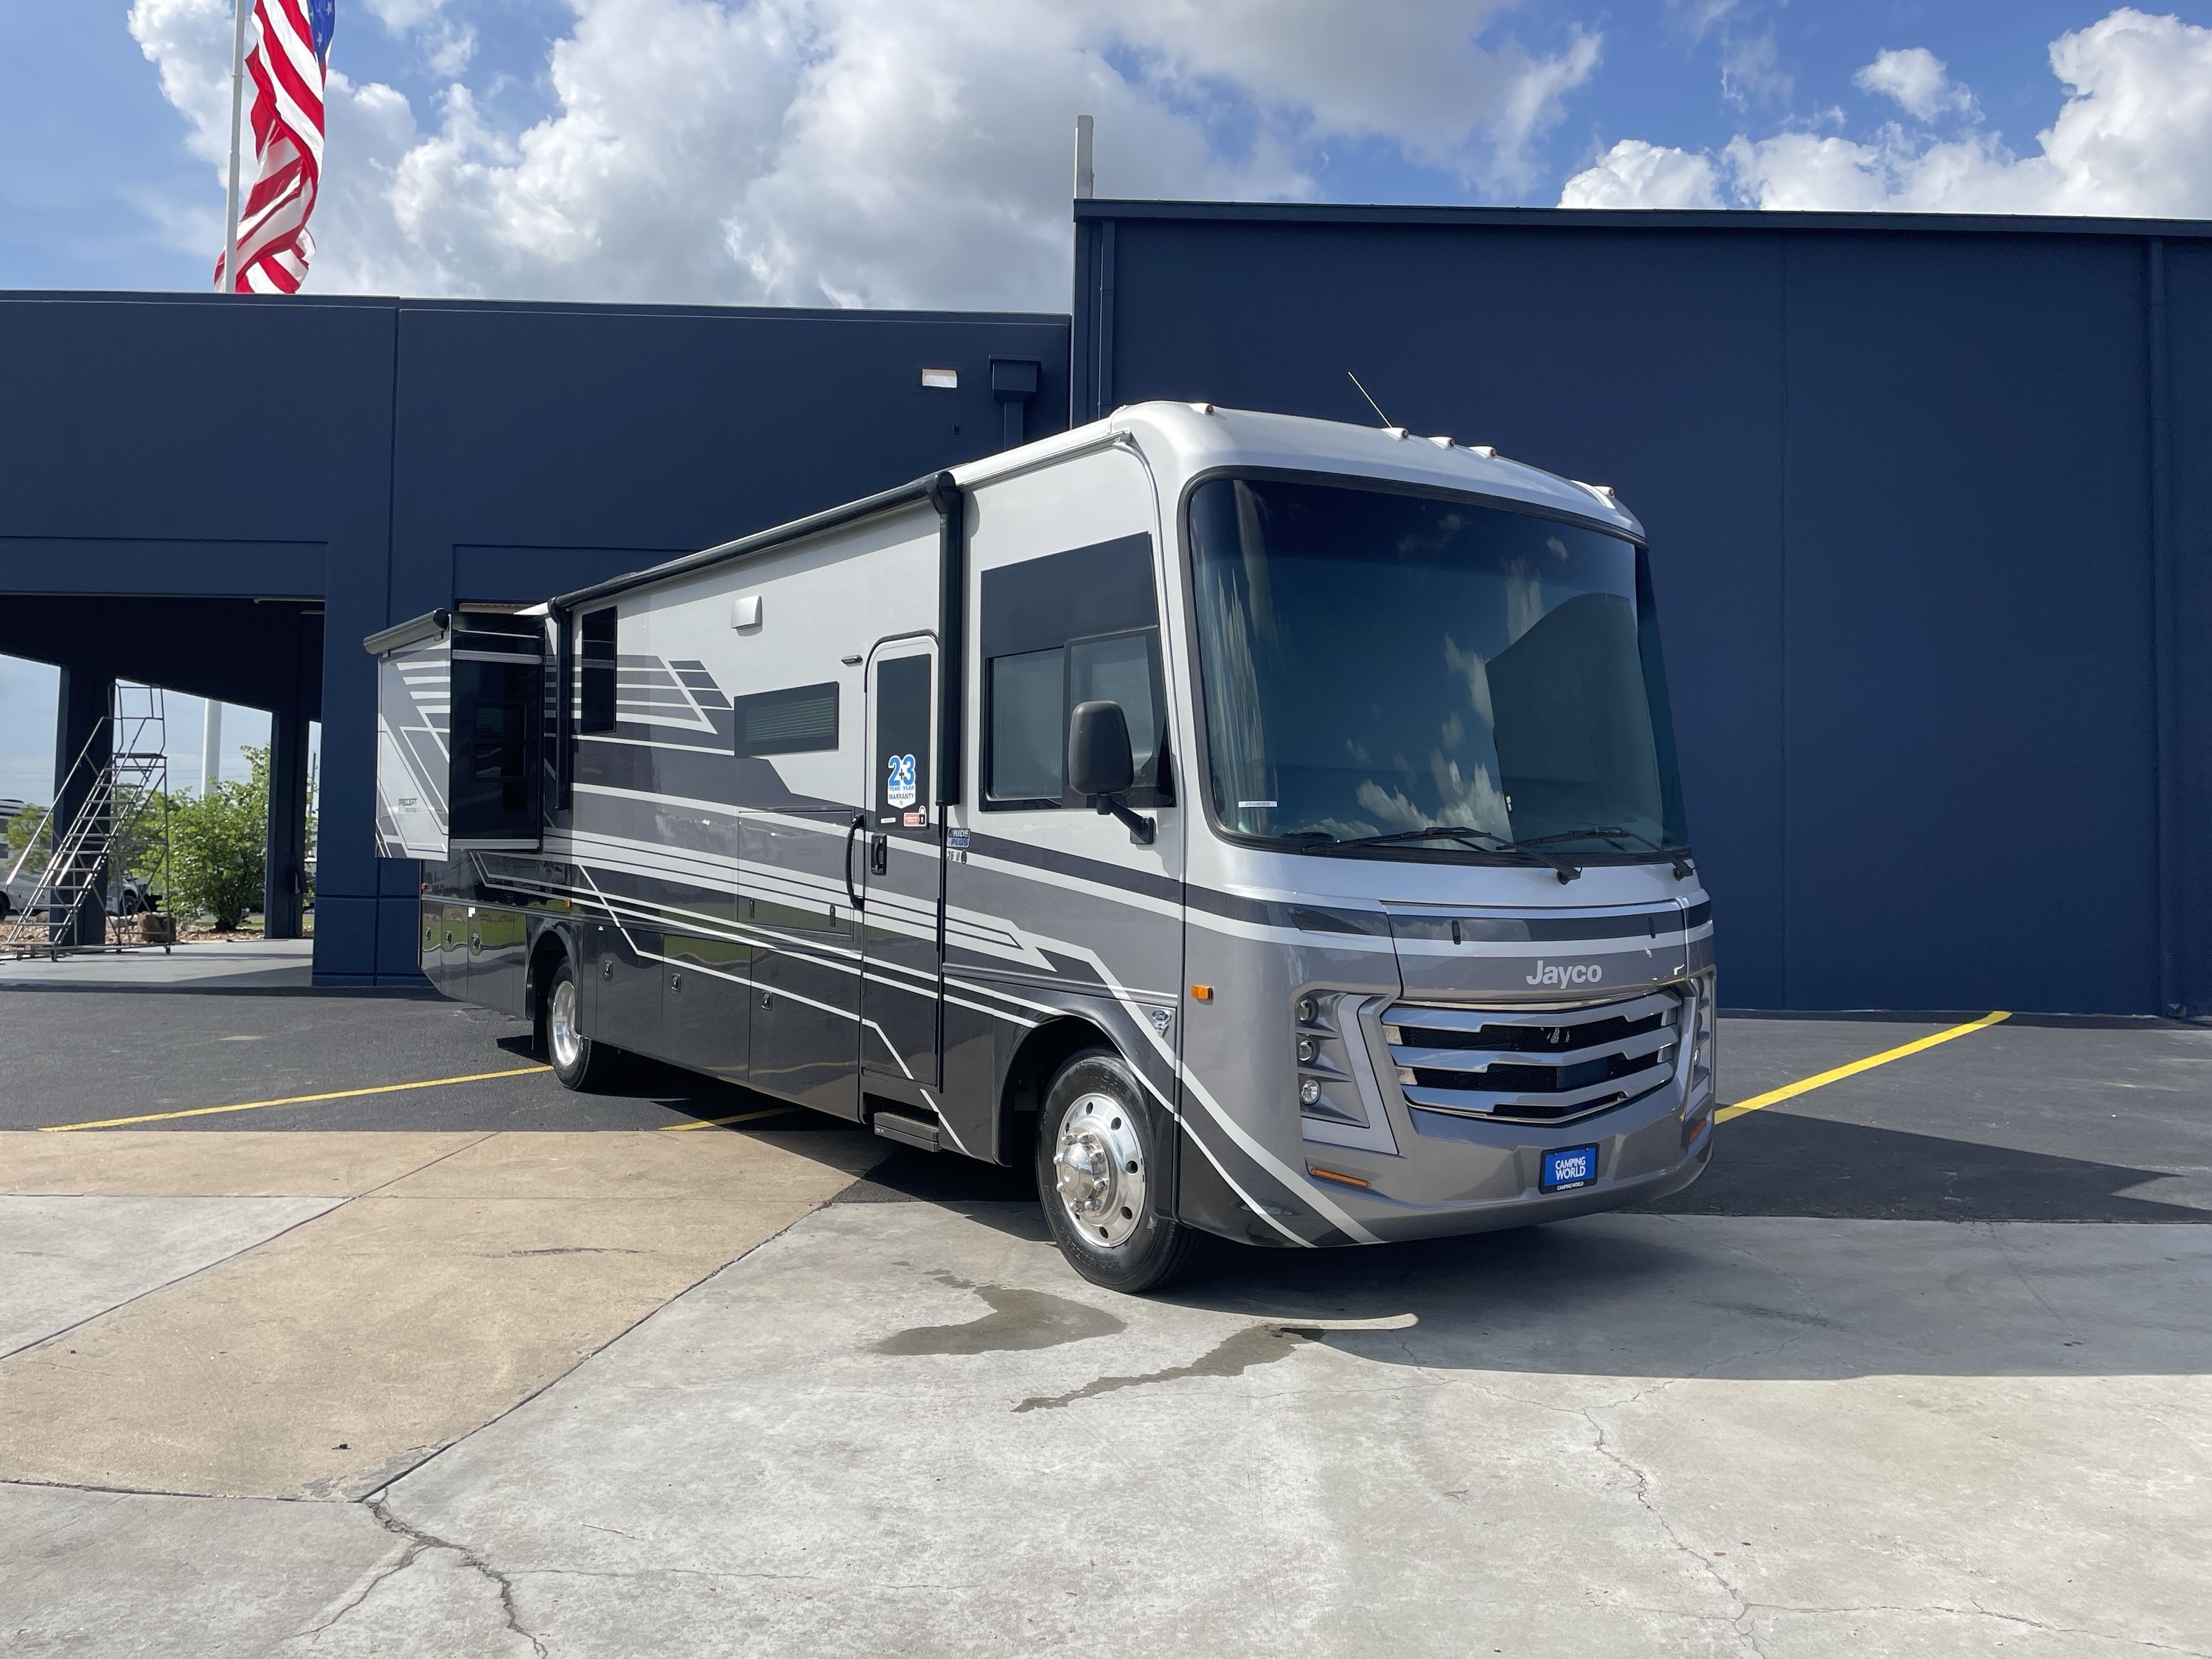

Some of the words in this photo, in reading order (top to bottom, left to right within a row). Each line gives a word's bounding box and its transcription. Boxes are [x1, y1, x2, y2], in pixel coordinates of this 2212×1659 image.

[1526, 960, 1602, 989] Jayco
[1555, 1156, 1586, 1170] CAMPING
[1555, 1166, 1586, 1180] WORLD
